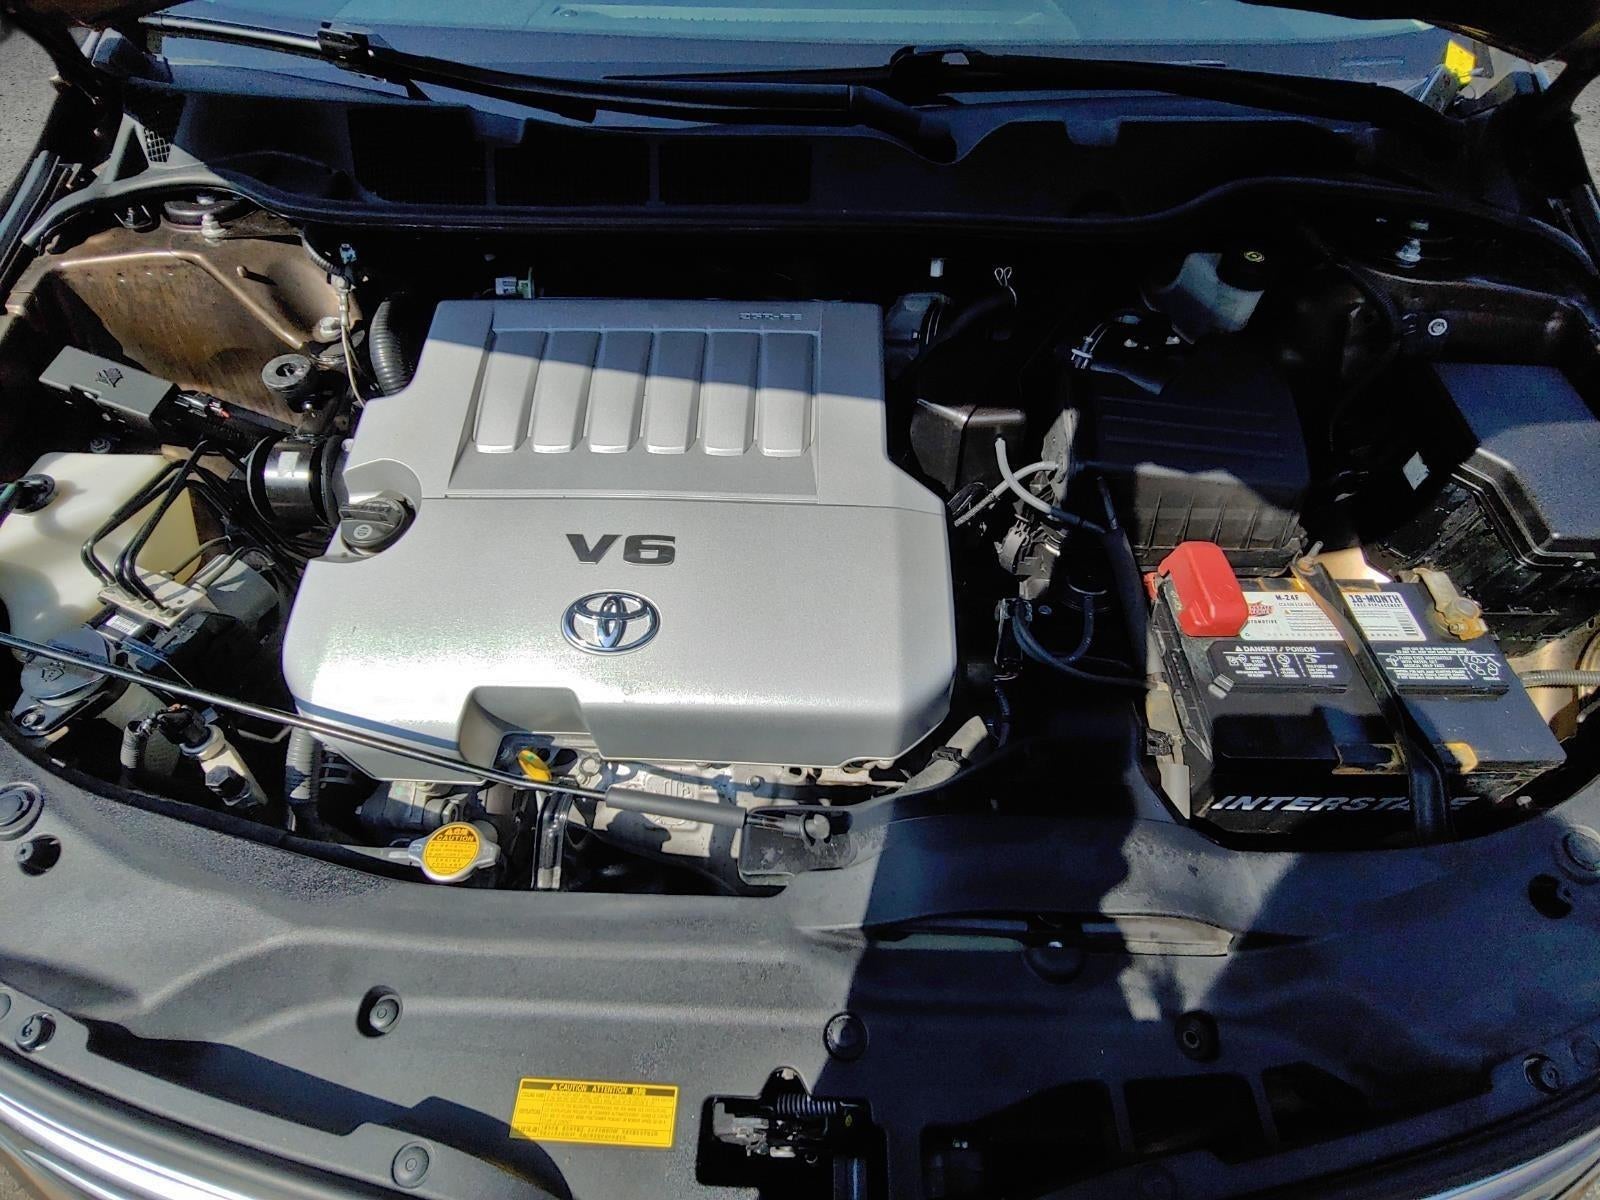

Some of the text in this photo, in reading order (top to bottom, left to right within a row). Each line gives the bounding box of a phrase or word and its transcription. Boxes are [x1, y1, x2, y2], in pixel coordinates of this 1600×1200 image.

[565, 533, 676, 566] V6
[1349, 594, 1402, 604] 18-MONTH
[1211, 796, 1480, 812] INTERSTAE
[558, 1083, 587, 1092] CAUTION
[591, 1086, 628, 1094] ATTENTION
